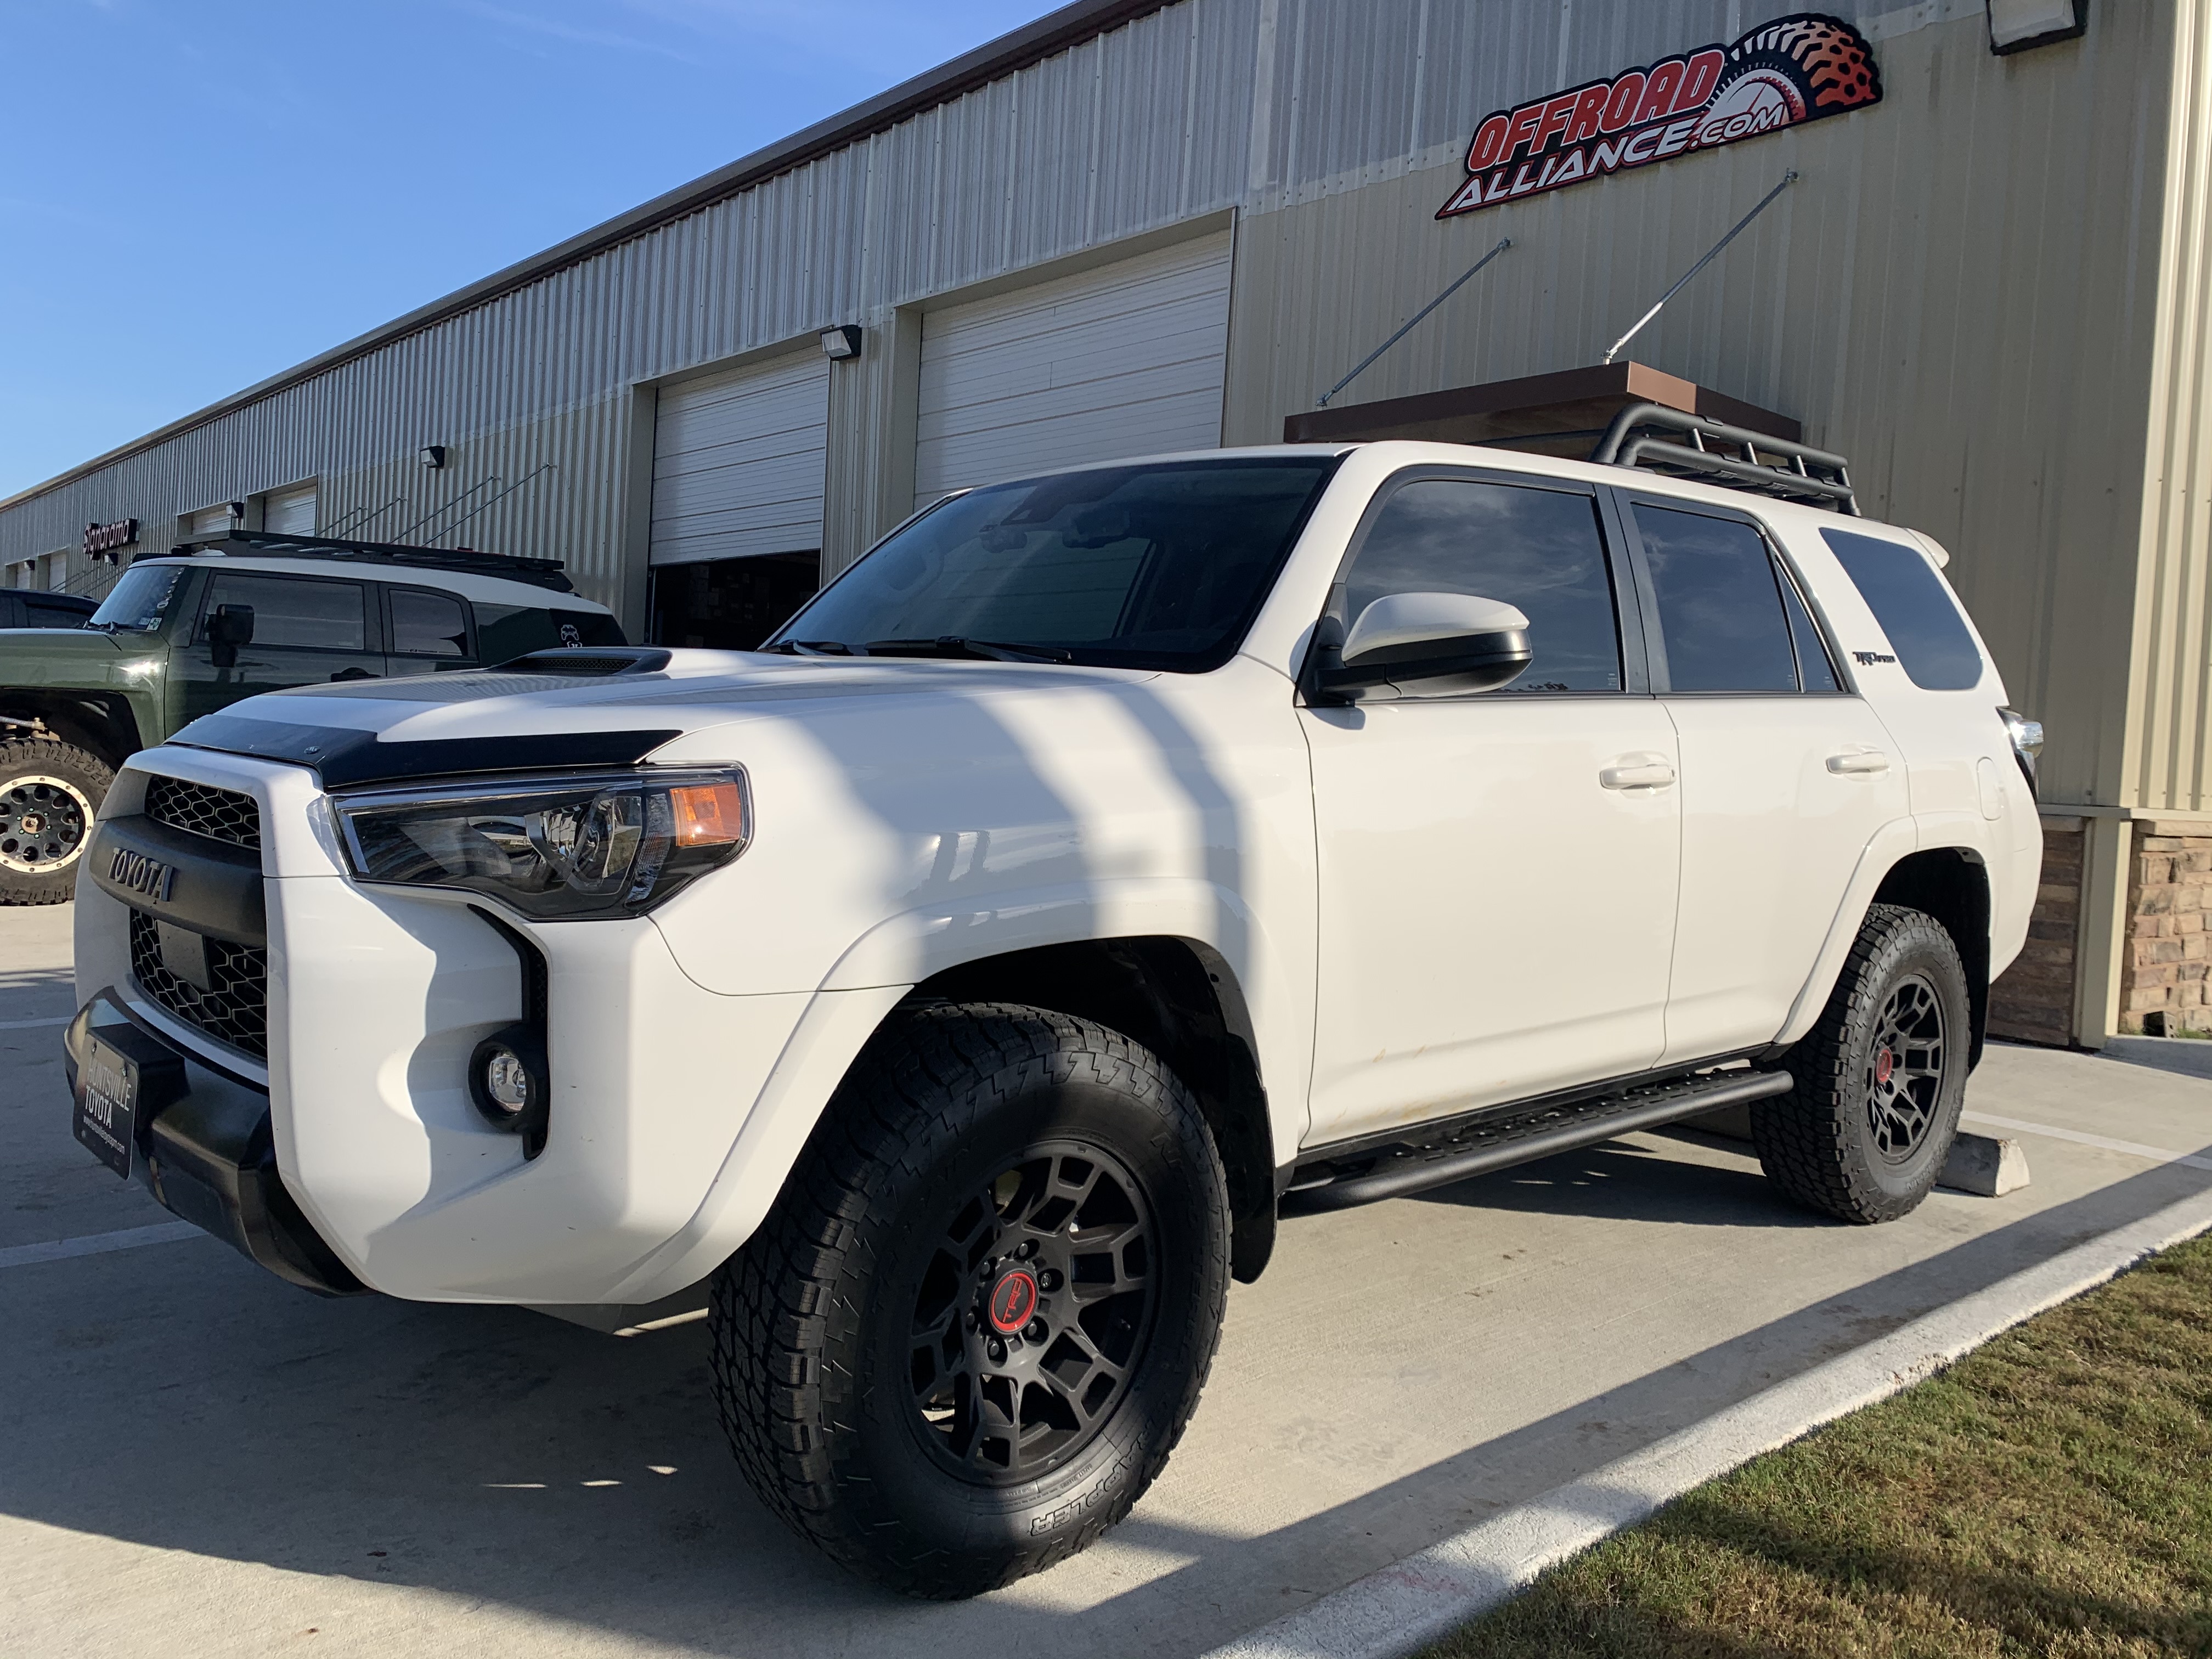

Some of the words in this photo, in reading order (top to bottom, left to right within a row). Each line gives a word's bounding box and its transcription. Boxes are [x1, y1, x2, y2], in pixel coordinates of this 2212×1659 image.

[1468, 49, 1726, 171] OFFROAD
[1446, 101, 1786, 211] ALLIANCE.COM
[82, 518, 131, 560] Signarama
[108, 847, 174, 902] TOYOTA
[84, 1084, 112, 1130] TOYOTA
[87, 1056, 132, 1112] HUNTSVILLE
[1002, 1278, 1023, 1323] TRD
